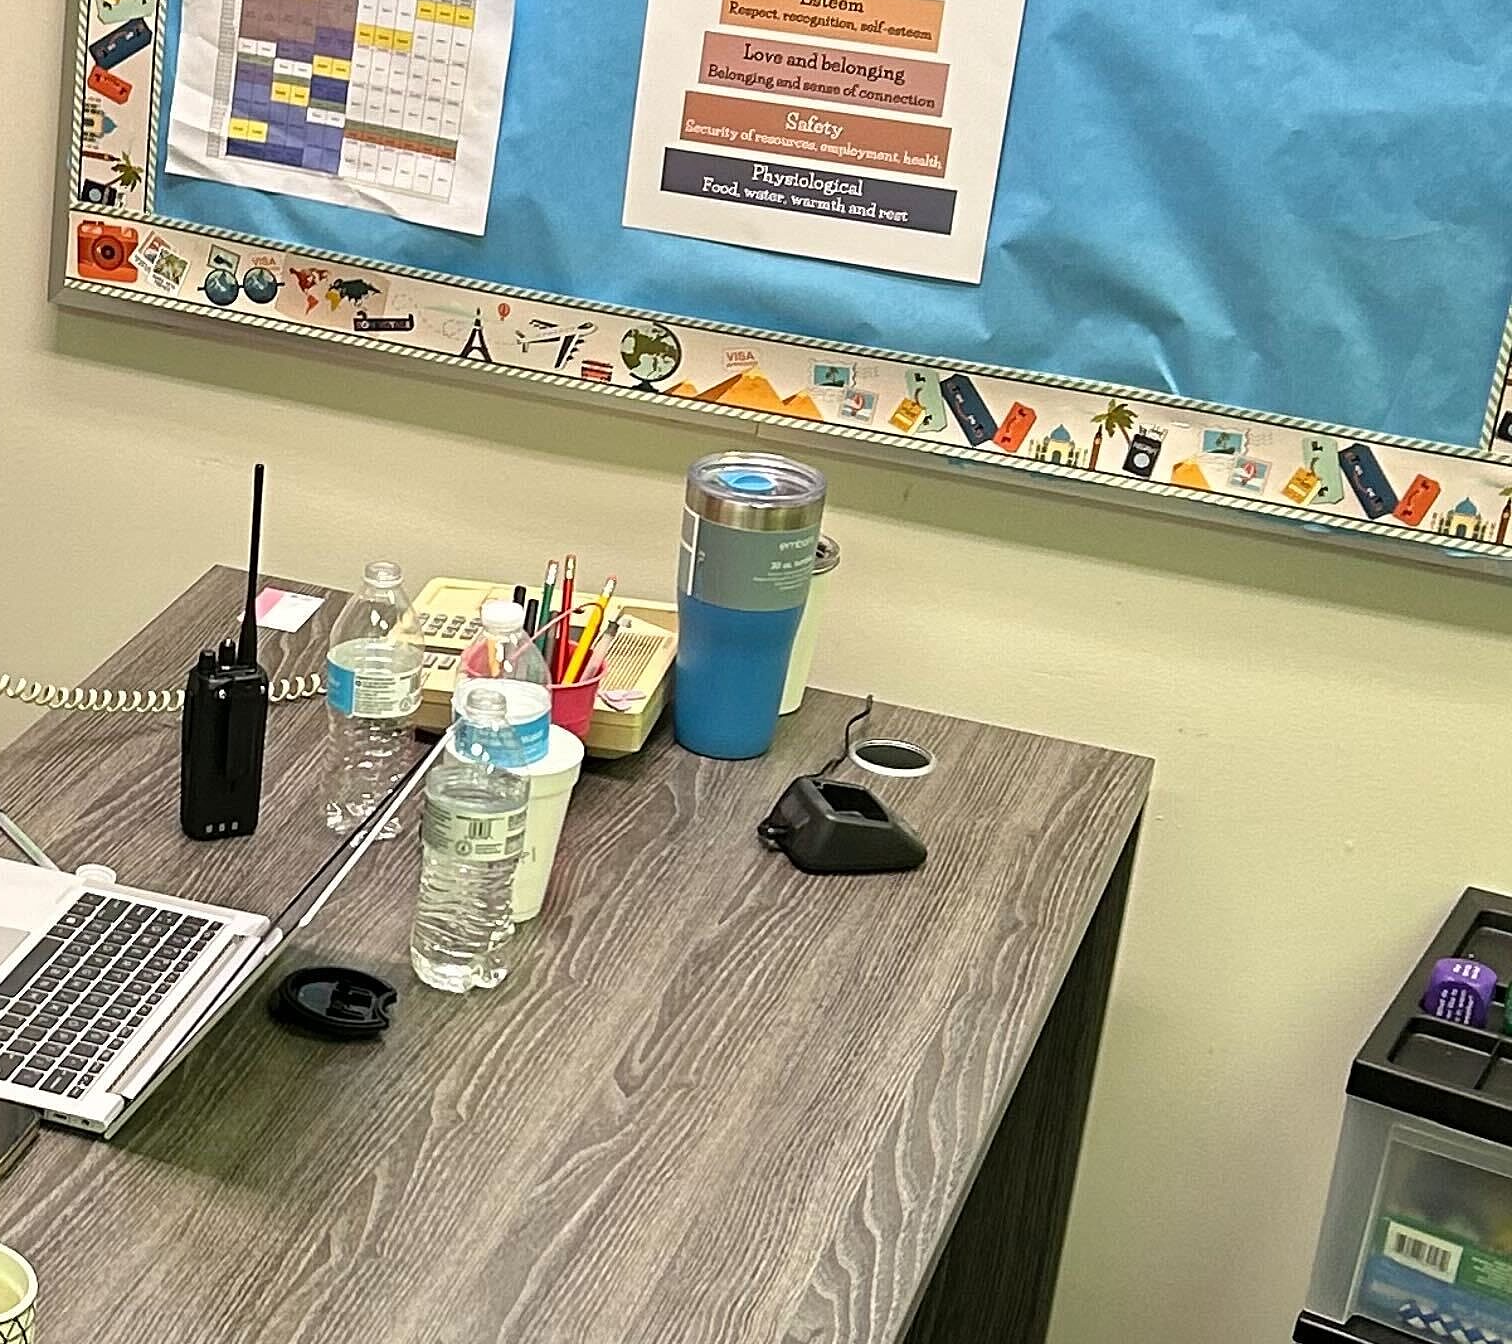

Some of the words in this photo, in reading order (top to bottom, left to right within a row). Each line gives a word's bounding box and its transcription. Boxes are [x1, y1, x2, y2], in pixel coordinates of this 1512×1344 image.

[860, 19, 933, 41] self-esteem
[743, 43, 784, 65] Love
[786, 52, 819, 71] and
[821, 52, 906, 86] belonging
[708, 63, 775, 89] Belonging
[776, 74, 801, 90] and
[803, 81, 841, 96] sense
[843, 83, 860, 98] of
[859, 87, 936, 109] connection
[785, 111, 844, 140] Safety
[684, 118, 739, 141] Security
[740, 129, 757, 143] of
[903, 152, 942, 170] health
[751, 163, 864, 197] Physiological
[790, 191, 846, 214] warmth
[848, 200, 877, 219] and
[878, 209, 909, 223] rest
